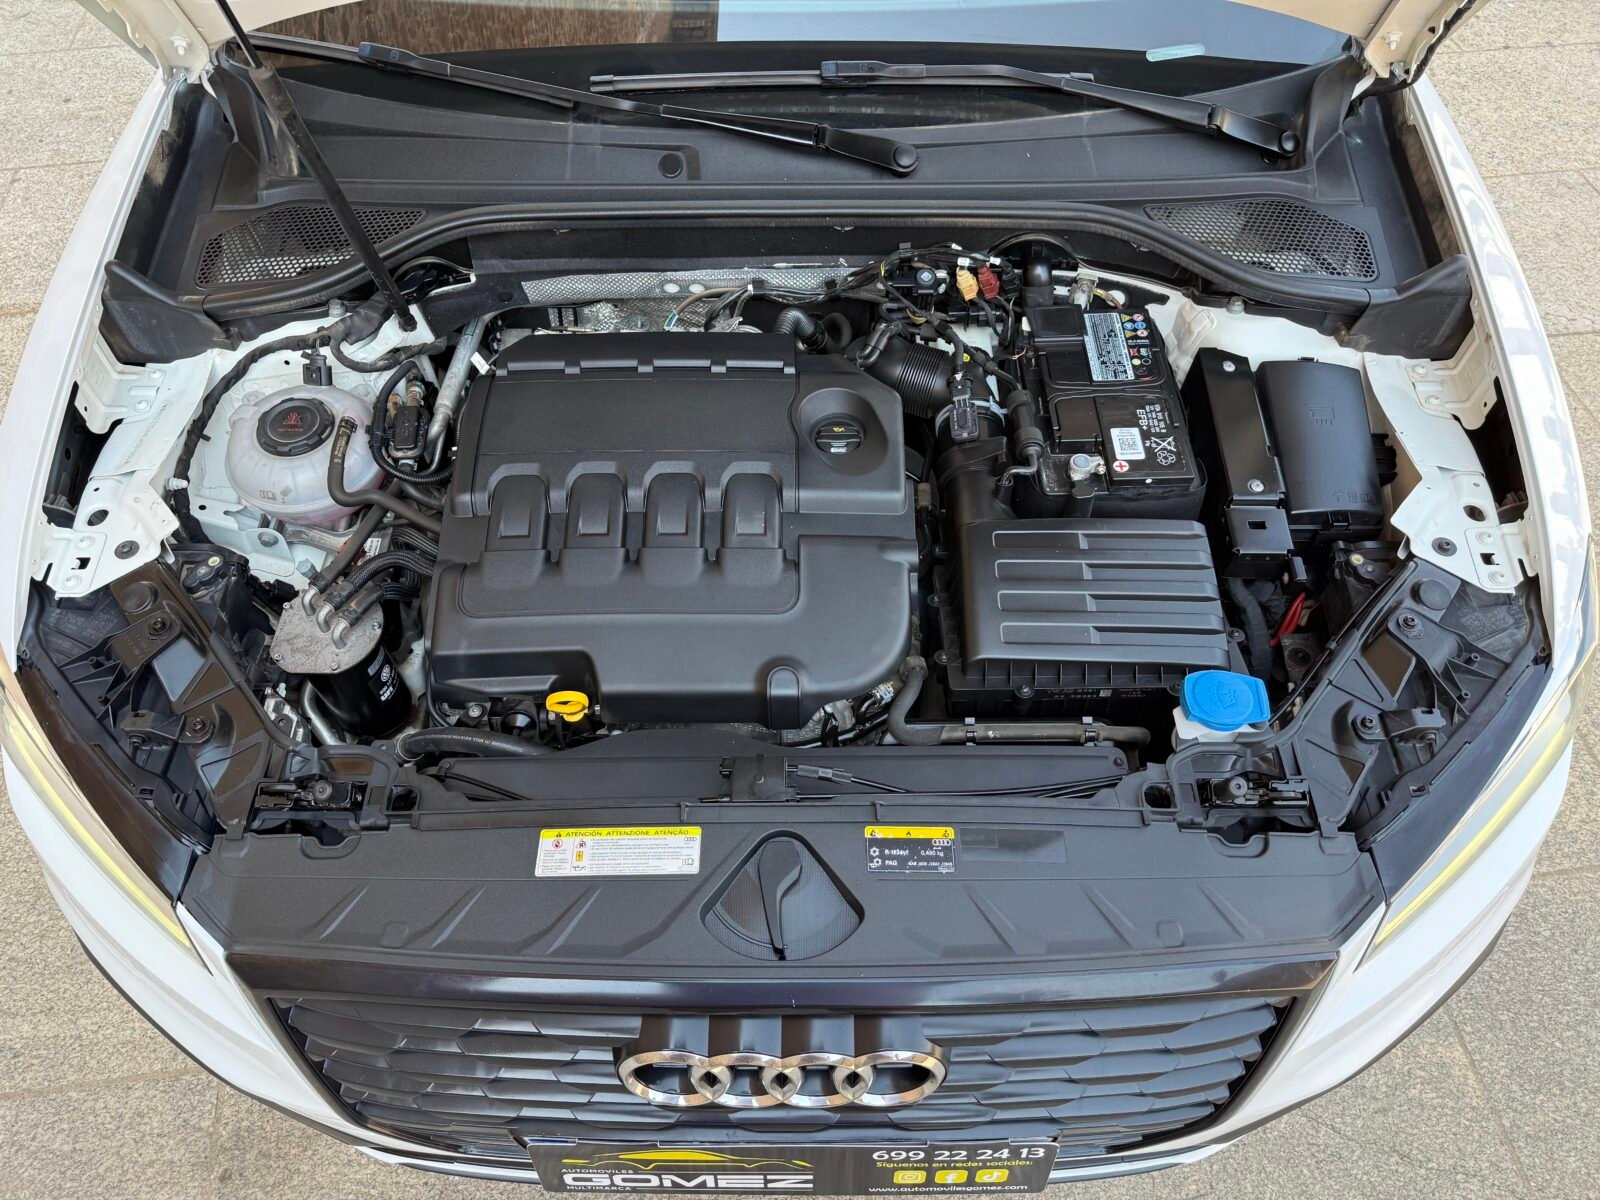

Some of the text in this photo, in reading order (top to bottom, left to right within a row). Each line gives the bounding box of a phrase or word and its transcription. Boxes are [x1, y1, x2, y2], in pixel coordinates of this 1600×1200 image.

[1136, 409, 1148, 430] EFB+
[654, 829, 689, 837] ATENÇÃO
[872, 1147, 1046, 1161] 699 22 24 13
[562, 1174, 814, 1188] GOMEZ
